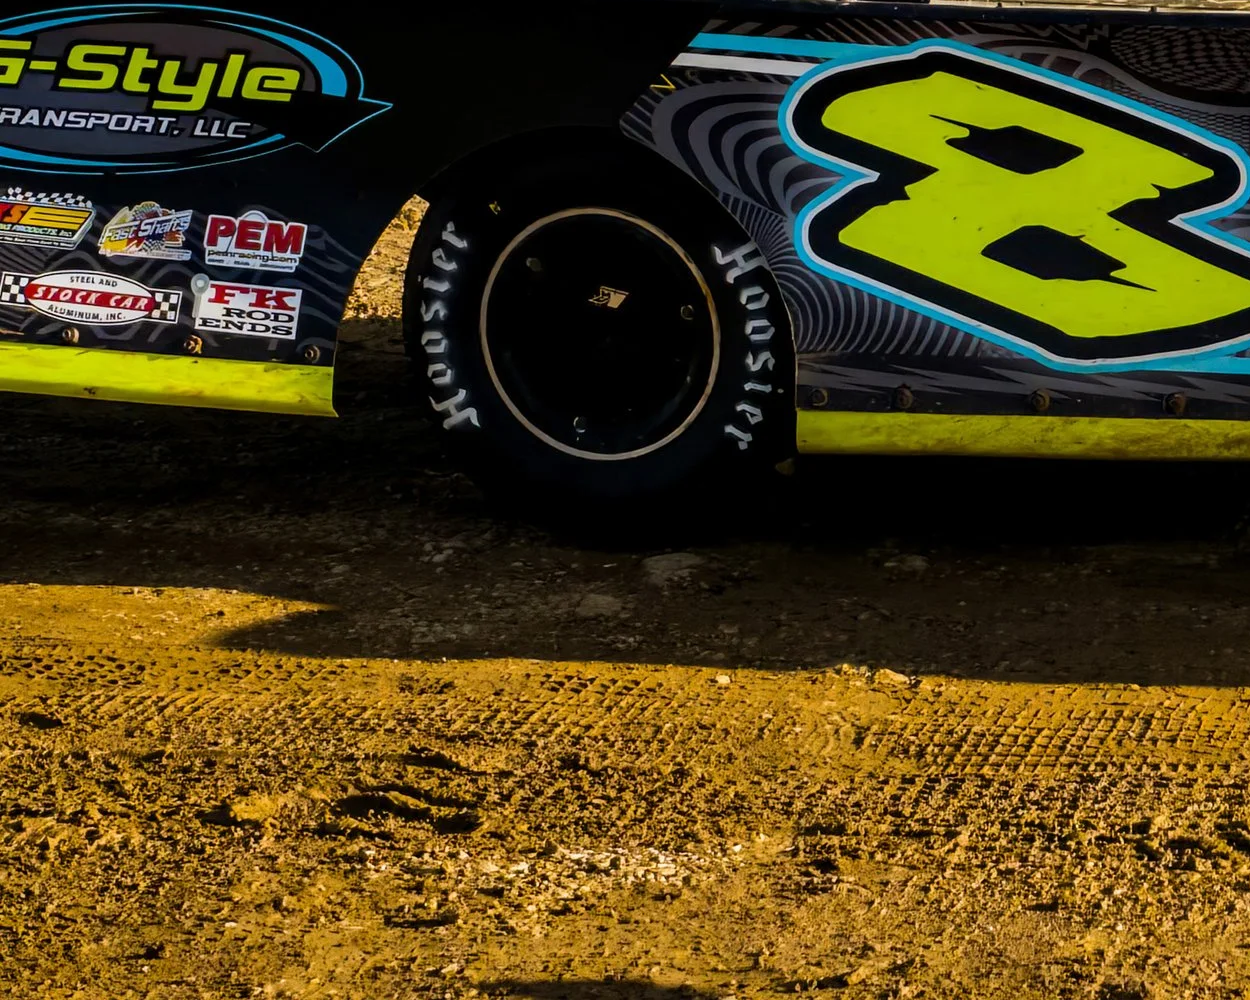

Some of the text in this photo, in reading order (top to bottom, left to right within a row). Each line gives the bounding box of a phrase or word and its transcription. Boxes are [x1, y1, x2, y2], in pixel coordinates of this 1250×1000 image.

[0, 107, 251, 139] RANSPORT, LLC
[0, 203, 91, 231] SE
[103, 214, 190, 242] Fast Shafts
[206, 217, 305, 254] PEM
[207, 249, 298, 263] pemracing.com
[70, 276, 118, 287] STEEL AND
[34, 286, 149, 310] STOCK CAR
[208, 283, 296, 312] FK
[48, 304, 126, 321] ALUMINUM, INC.
[222, 307, 295, 323] ROD
[418, 221, 481, 431] Hoosier
[198, 318, 293, 336] ENDS
[712, 240, 784, 450] Hoosier
